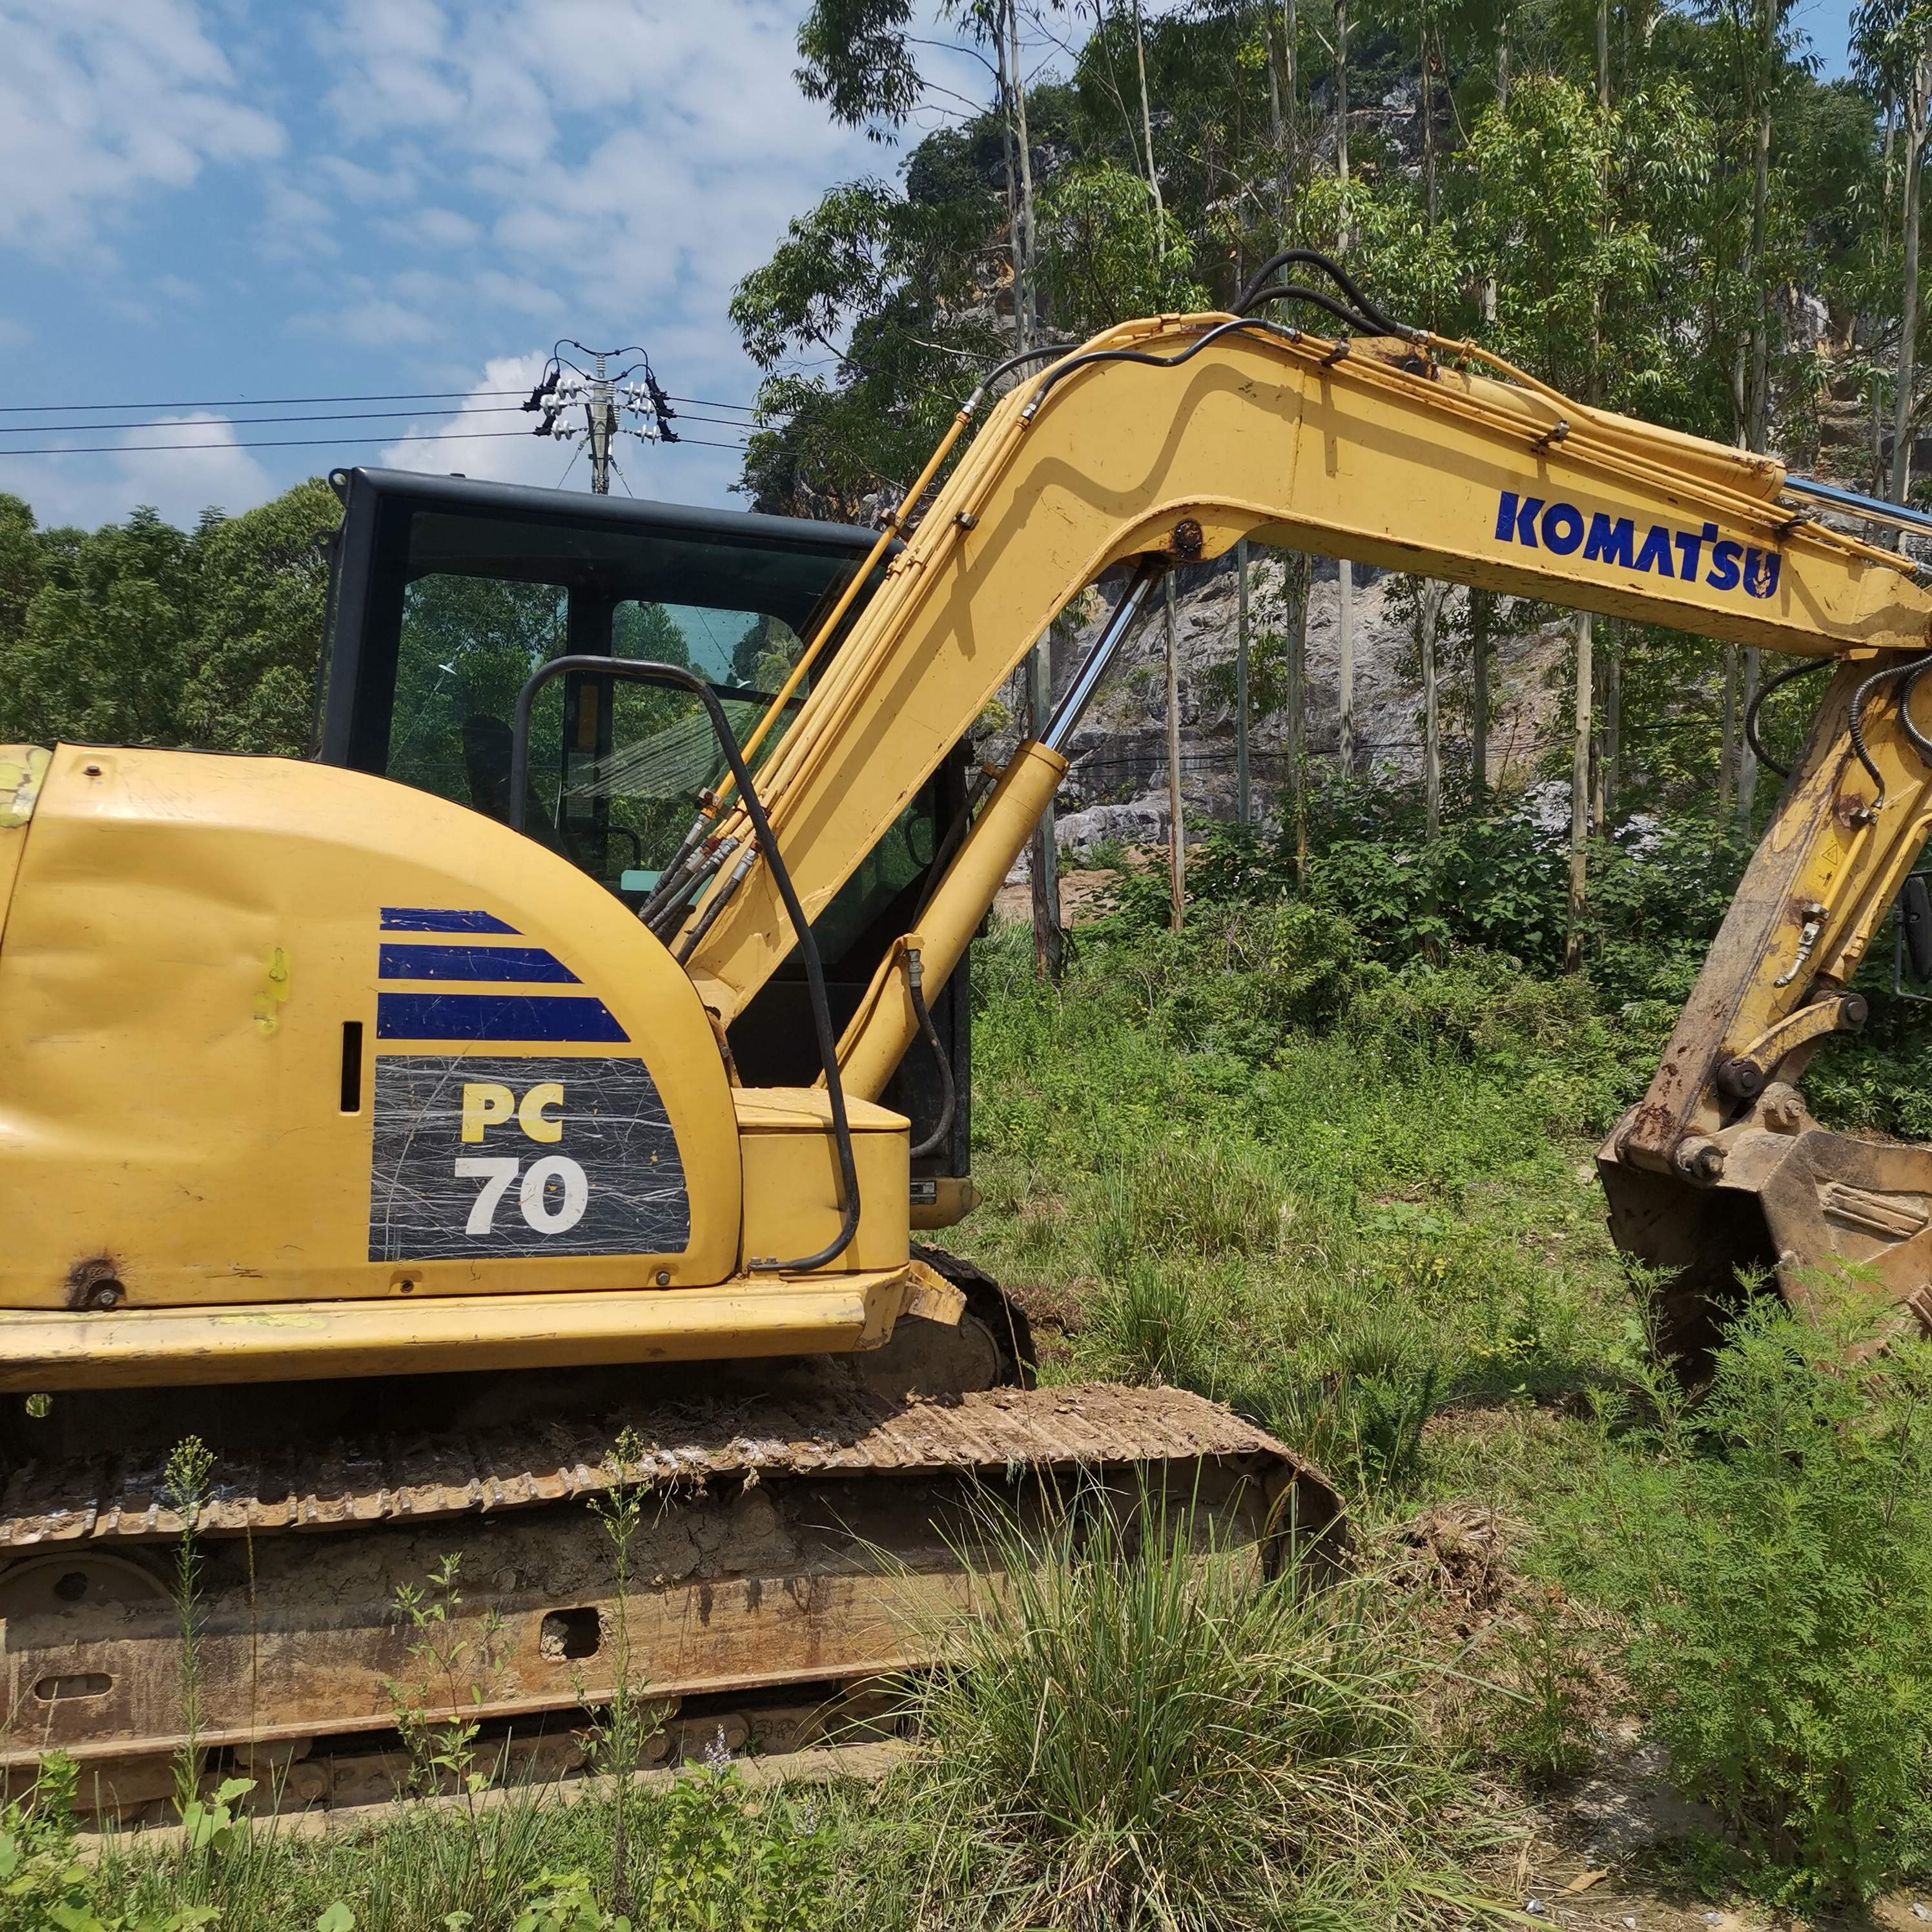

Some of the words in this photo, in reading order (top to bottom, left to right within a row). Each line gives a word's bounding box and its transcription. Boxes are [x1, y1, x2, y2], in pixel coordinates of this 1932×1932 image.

[1495, 491, 1782, 599] KOMATSU
[462, 1084, 564, 1142] PC
[455, 1155, 588, 1235] 70
